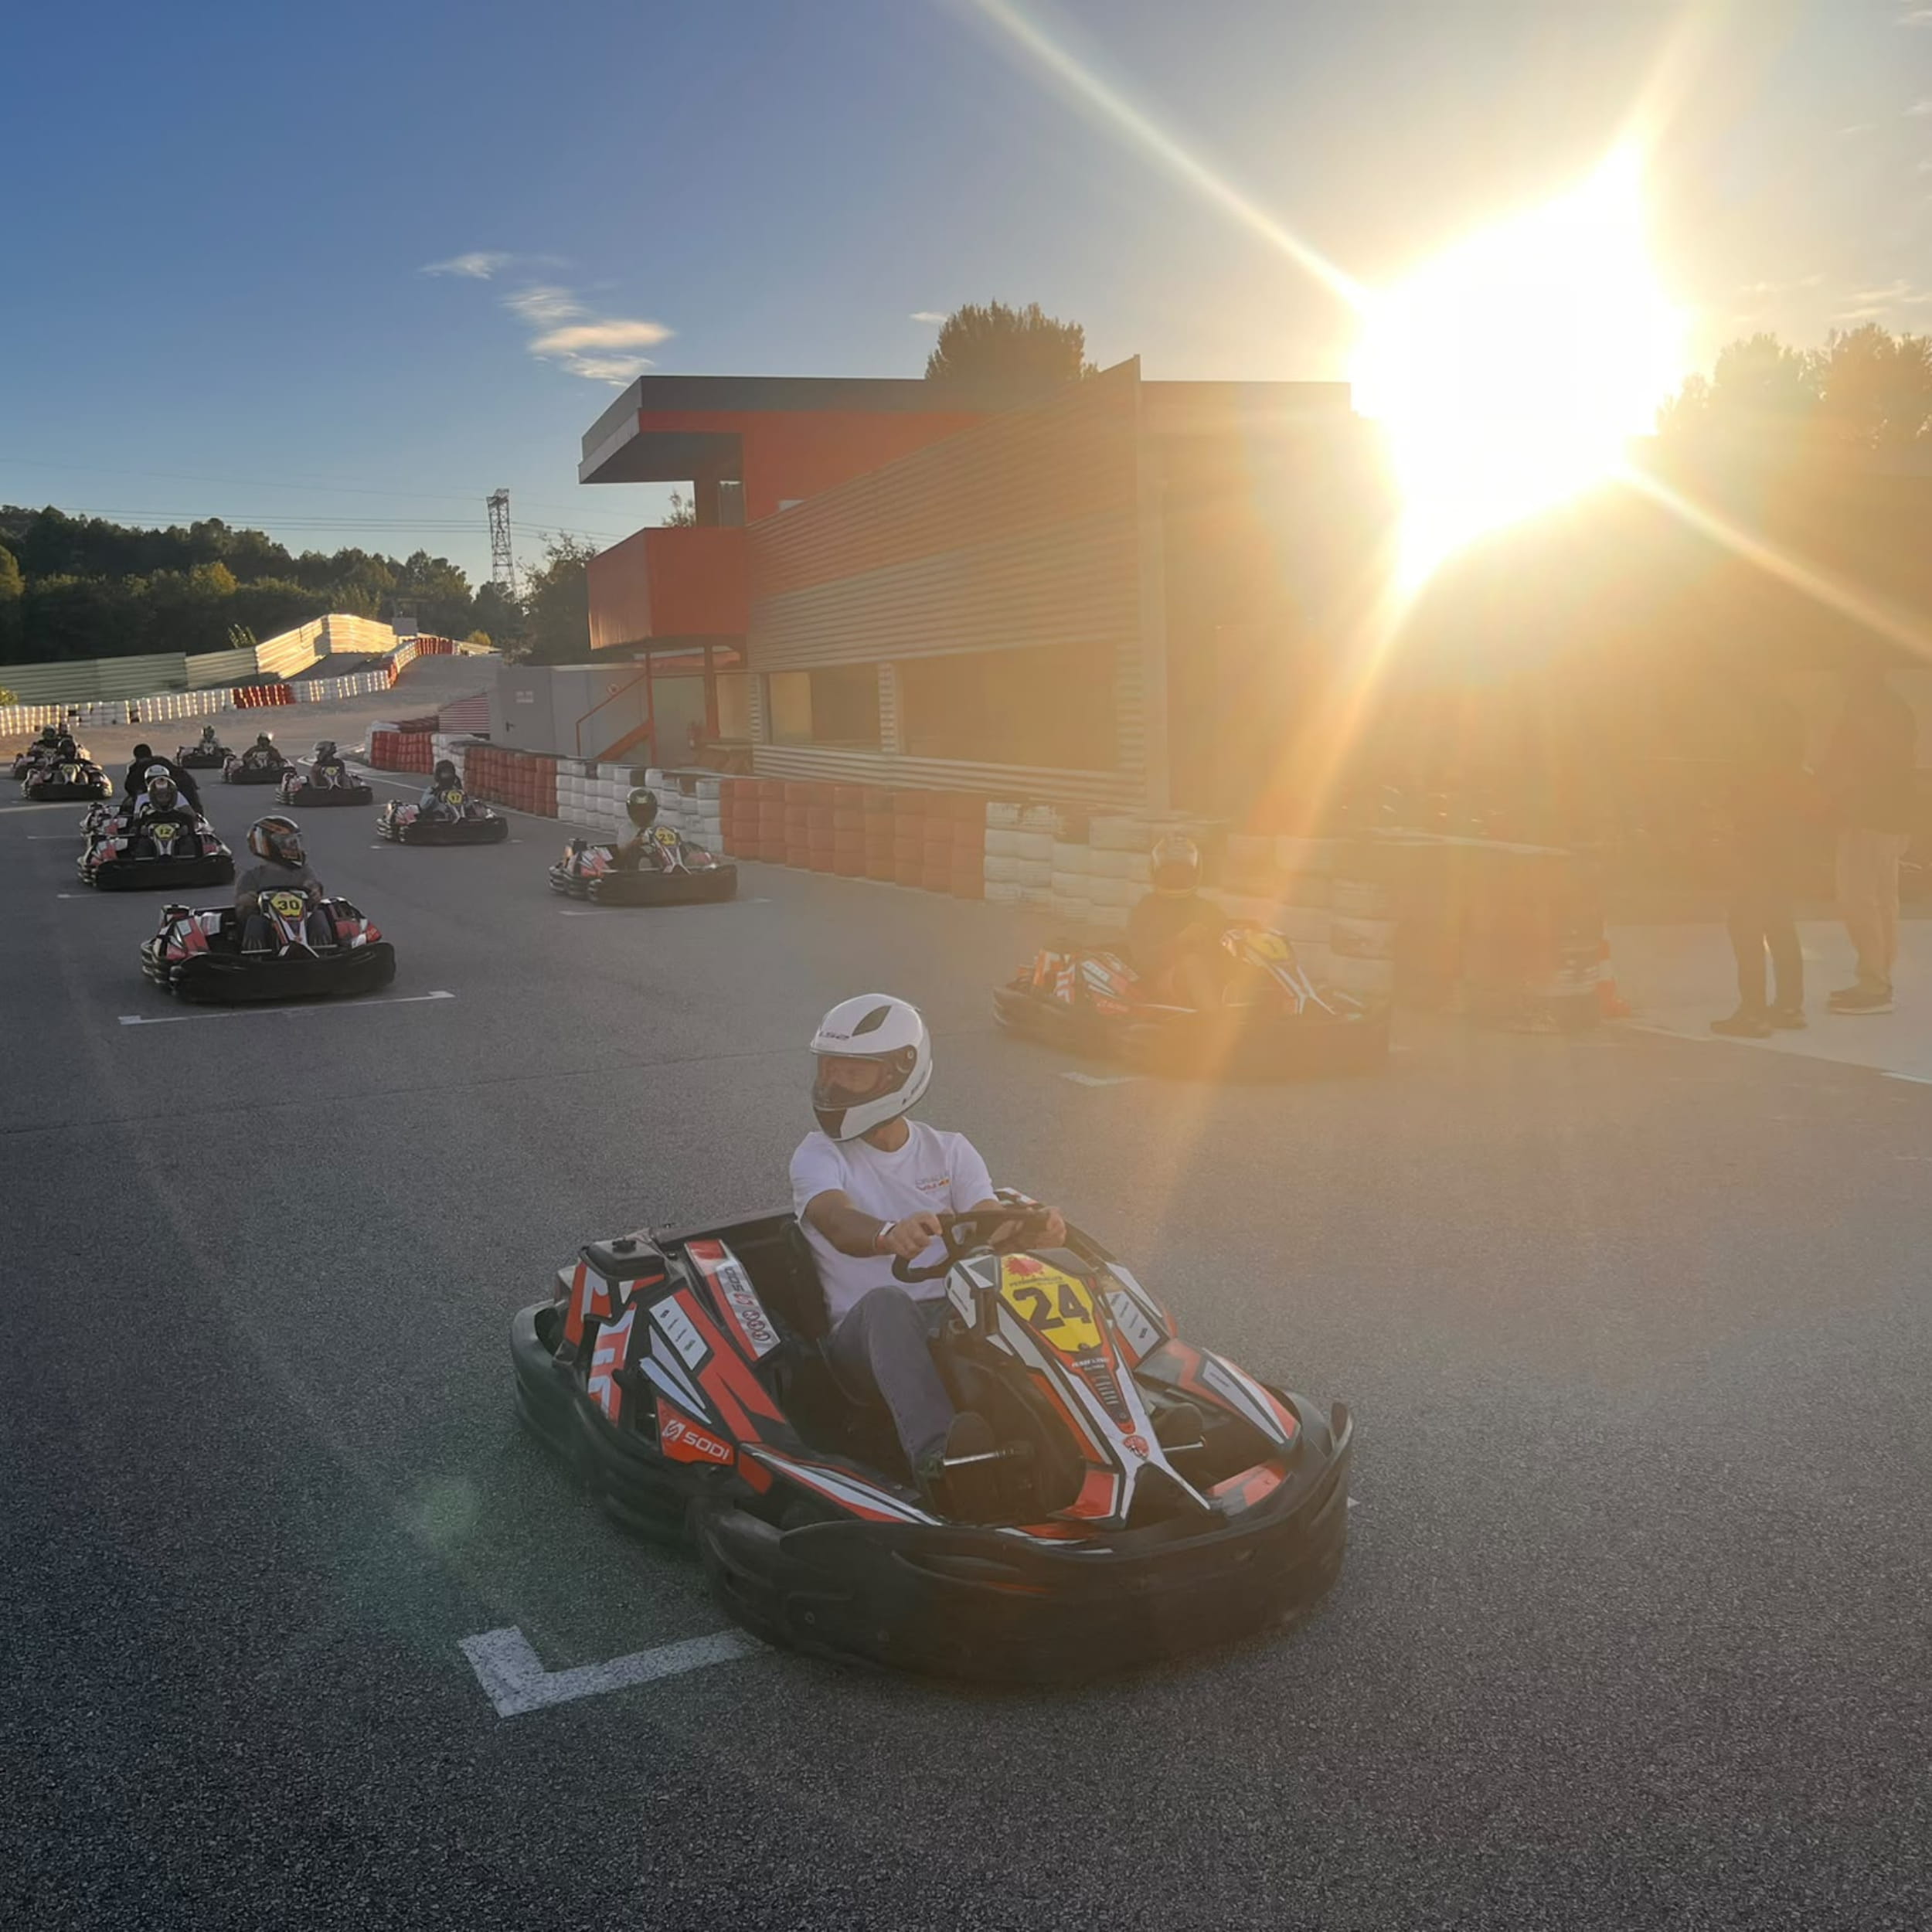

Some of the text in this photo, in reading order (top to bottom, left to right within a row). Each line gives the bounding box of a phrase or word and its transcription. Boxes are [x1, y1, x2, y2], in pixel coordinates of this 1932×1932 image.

[277, 900, 300, 910] 30
[1012, 1284, 1092, 1330] 24
[682, 1430, 730, 1461] SODI
